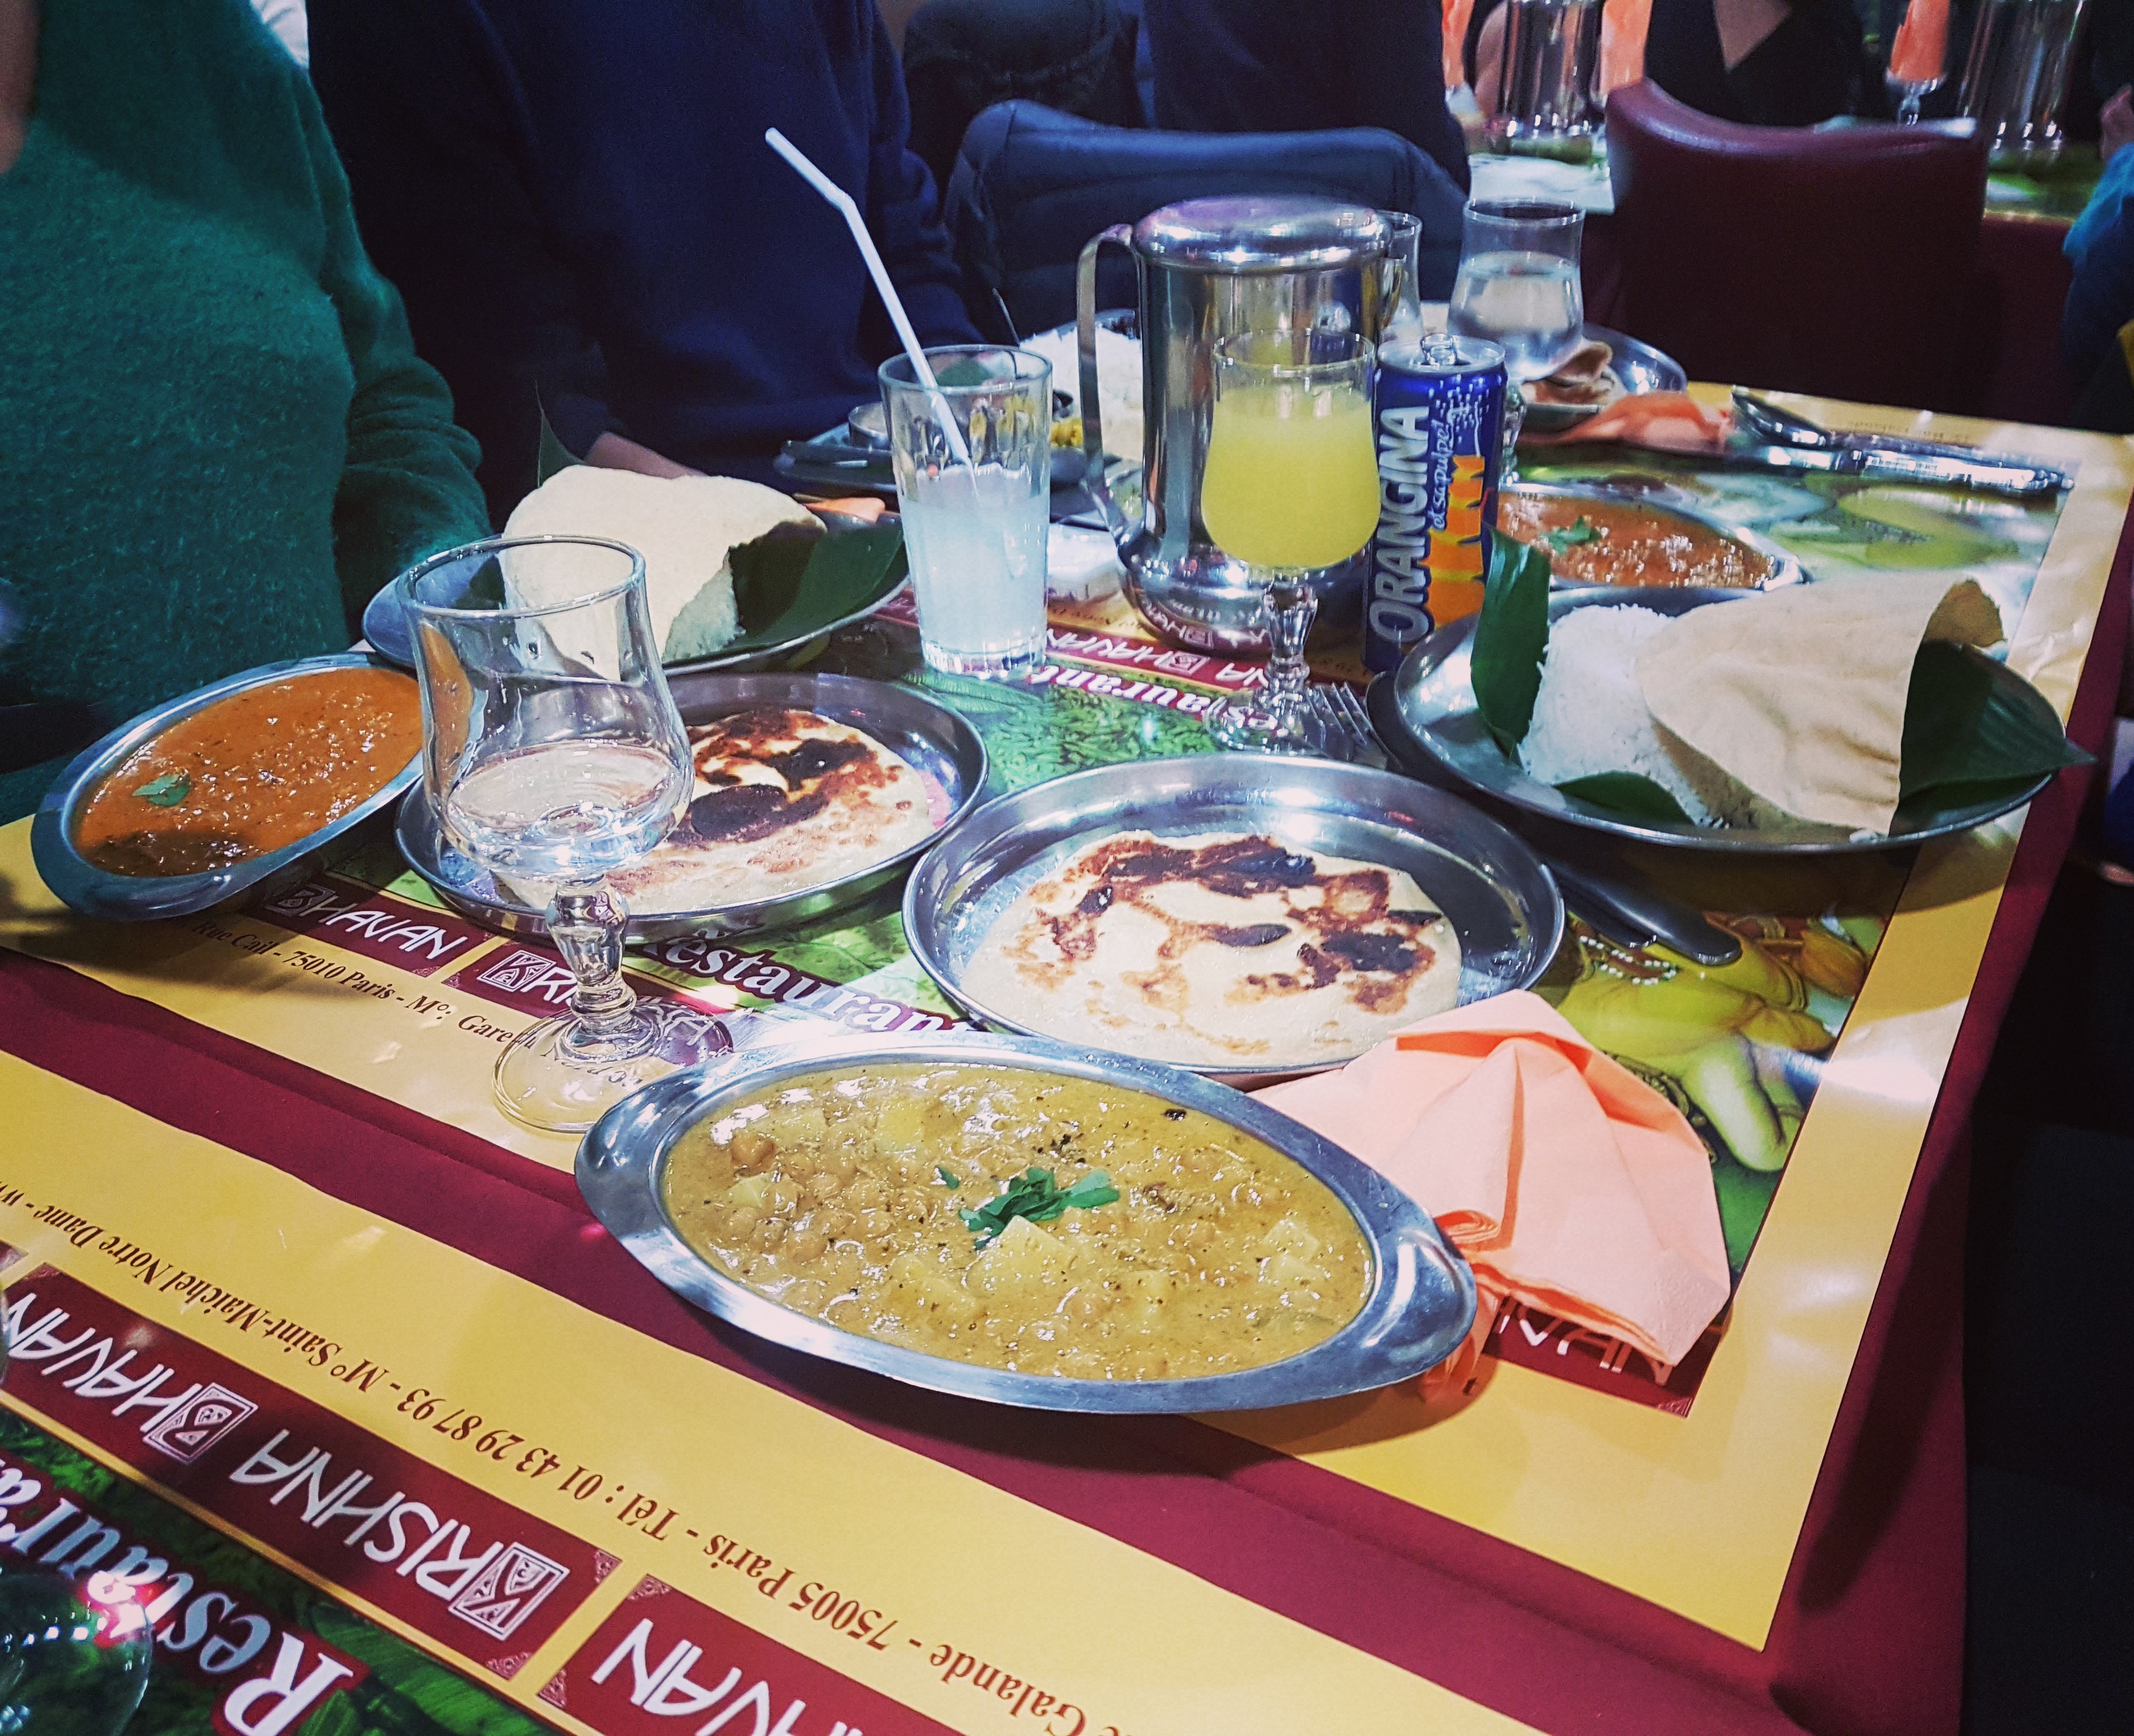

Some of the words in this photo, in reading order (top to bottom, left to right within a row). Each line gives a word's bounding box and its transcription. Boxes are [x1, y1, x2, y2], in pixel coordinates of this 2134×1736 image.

[1369, 405, 1430, 644] ORANGINA
[282, 950, 346, 979] 75010
[343, 972, 396, 1001] Paris
[458, 1014, 514, 1044] Gare
[33, 1204, 104, 1249] Dame
[99, 1236, 173, 1285] Notre
[158, 1270, 343, 1367] Saint-Maichel
[397, 1388, 447, 1419] 93
[475, 1429, 525, 1459] 29
[515, 1447, 560, 1479] 43
[557, 1465, 605, 1502] 01
[617, 1493, 681, 1543] Tél
[703, 1533, 799, 1600] Paris
[791, 1582, 901, 1651] 75005
[928, 1643, 1089, 1736] Galande
